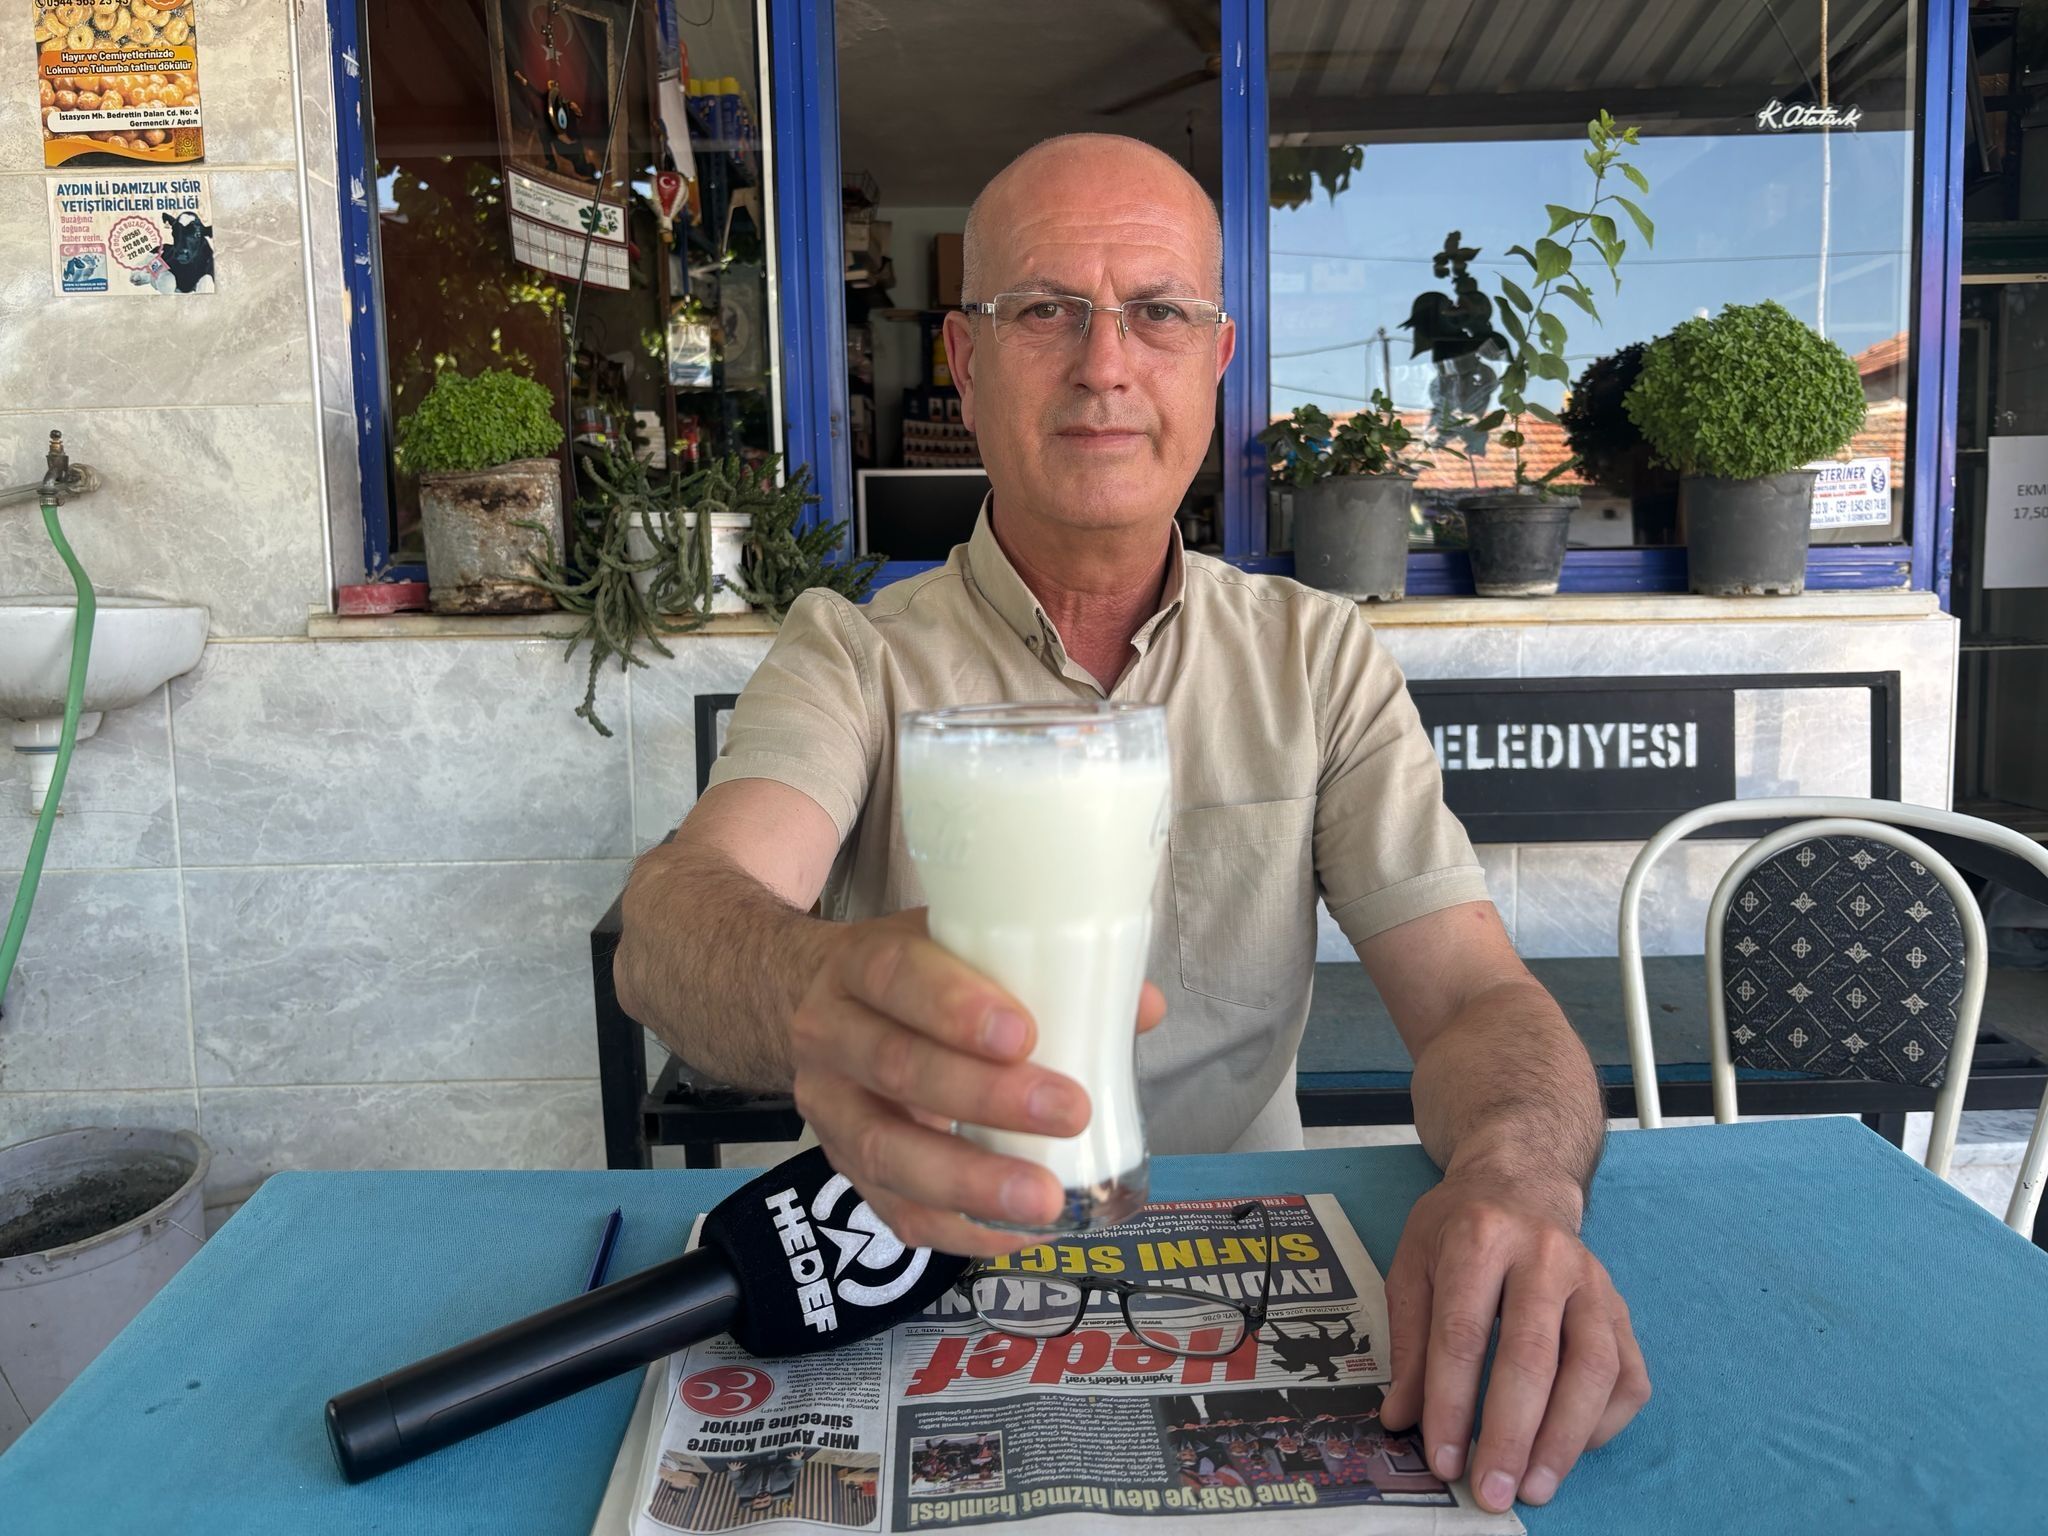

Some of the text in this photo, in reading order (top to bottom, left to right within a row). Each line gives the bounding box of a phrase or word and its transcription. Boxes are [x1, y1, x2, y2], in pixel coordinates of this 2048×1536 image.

[62, 52, 86, 63] Hayır
[99, 50, 174, 62] Cemiyetlerinizde
[46, 60, 192, 75] Lokma ve Tulumba tatlısı dökülür
[59, 112, 91, 121] İstasyon
[92, 112, 105, 120] Mh.
[107, 111, 142, 119] Bedrettin
[144, 110, 165, 118] Dalan
[130, 120, 170, 128] Germencik
[177, 119, 198, 127] Aydın
[57, 179, 201, 196] AYDIN İLİ DAMIZLIK SIĞIR
[62, 196, 199, 214] YETİŞTİRİCİLERİ BİRLİĞİ
[2018, 484, 2048, 496] EKM
[1434, 722, 1698, 770] ELEDIYESI
[1173, 1224, 1208, 1232] Özgür
[1212, 1222, 1257, 1231] Başkanı
[765, 1187, 838, 1332] HEDEF
[1136, 1234, 1320, 1272] SAFINI
[904, 1328, 1259, 1396] Hedef
[1065, 1374, 1173, 1385] Aydın'ın Hedef'i var!
[699, 1413, 853, 1436] sürecine giriyor
[687, 1428, 859, 1454] MHP Aydın kongre
[910, 1480, 1320, 1526] Çine OSB'ye dev hizmet hamlesi
